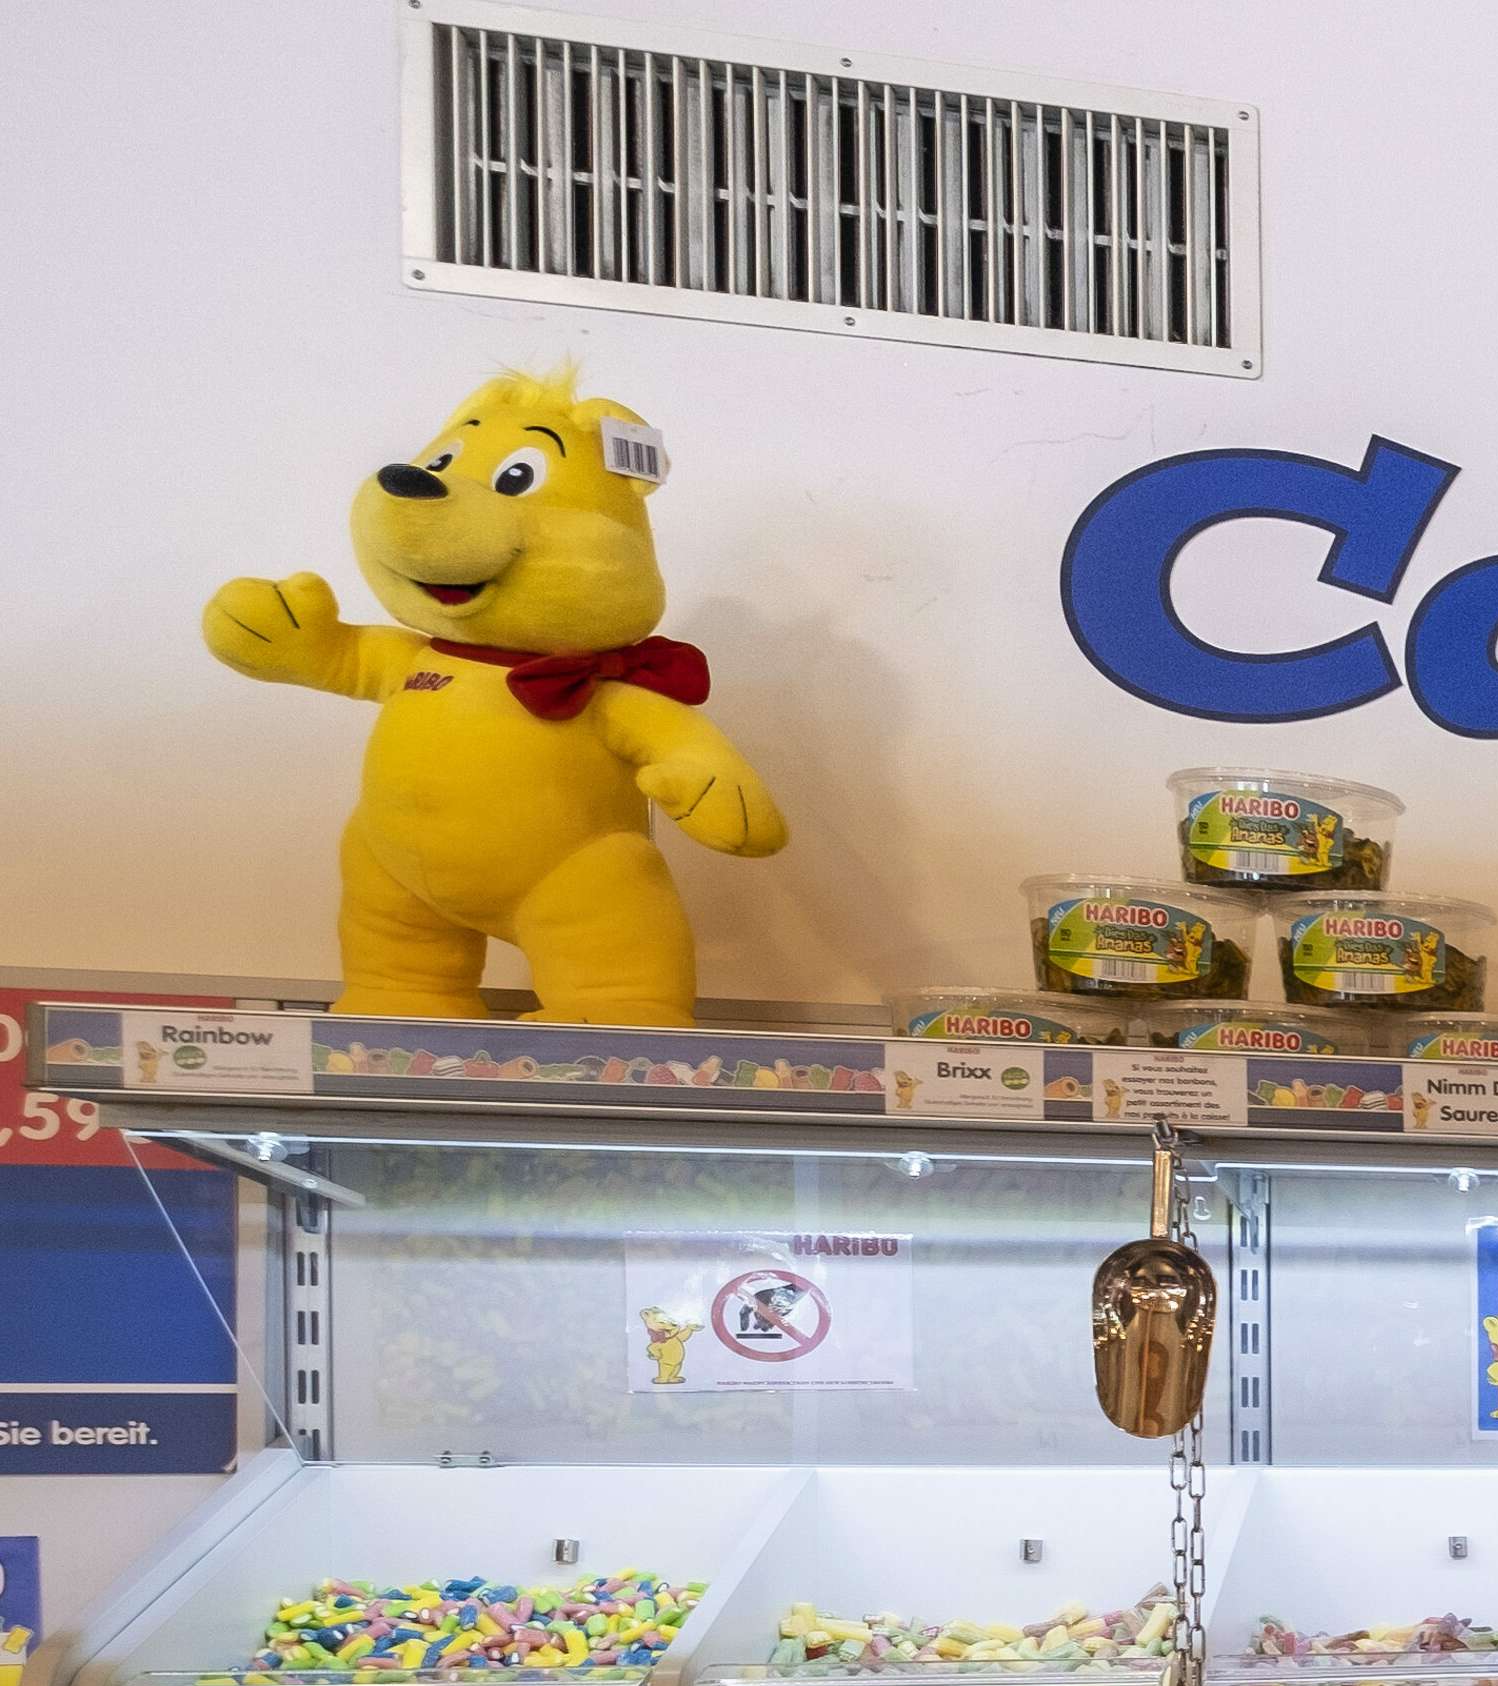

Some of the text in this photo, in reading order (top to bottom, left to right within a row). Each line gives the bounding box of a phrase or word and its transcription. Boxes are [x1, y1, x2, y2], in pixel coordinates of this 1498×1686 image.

[1221, 796, 1299, 819] HARIBO
[1229, 829, 1286, 845] Ananas
[1085, 904, 1168, 927] HARIBO
[1324, 917, 1403, 939] HARIBO
[1095, 936, 1153, 954] Ananas
[1336, 948, 1391, 964] Ananas
[162, 1025, 273, 1046] Rainbow
[946, 1016, 1031, 1039] HARIBO
[1218, 1028, 1301, 1051] HARIBO
[937, 1061, 992, 1079] Brixx
[1427, 1079, 1487, 1096] Nimm
[52, 1420, 158, 1446] bereit.
